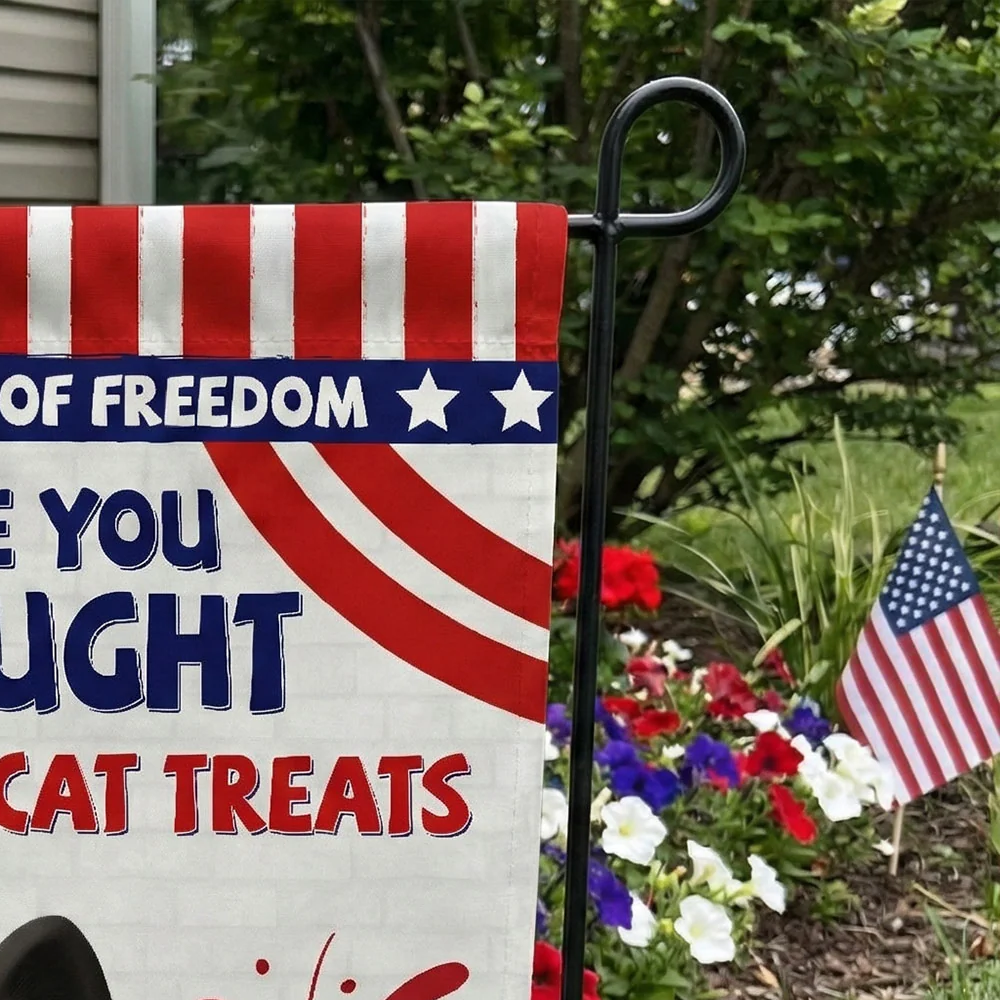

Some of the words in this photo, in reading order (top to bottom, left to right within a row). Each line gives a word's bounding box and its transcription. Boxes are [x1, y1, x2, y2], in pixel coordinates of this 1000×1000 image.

[91, 374, 368, 429] FREEDOM
[38, 487, 222, 574] YOU
[162, 752, 473, 839] TREATS
